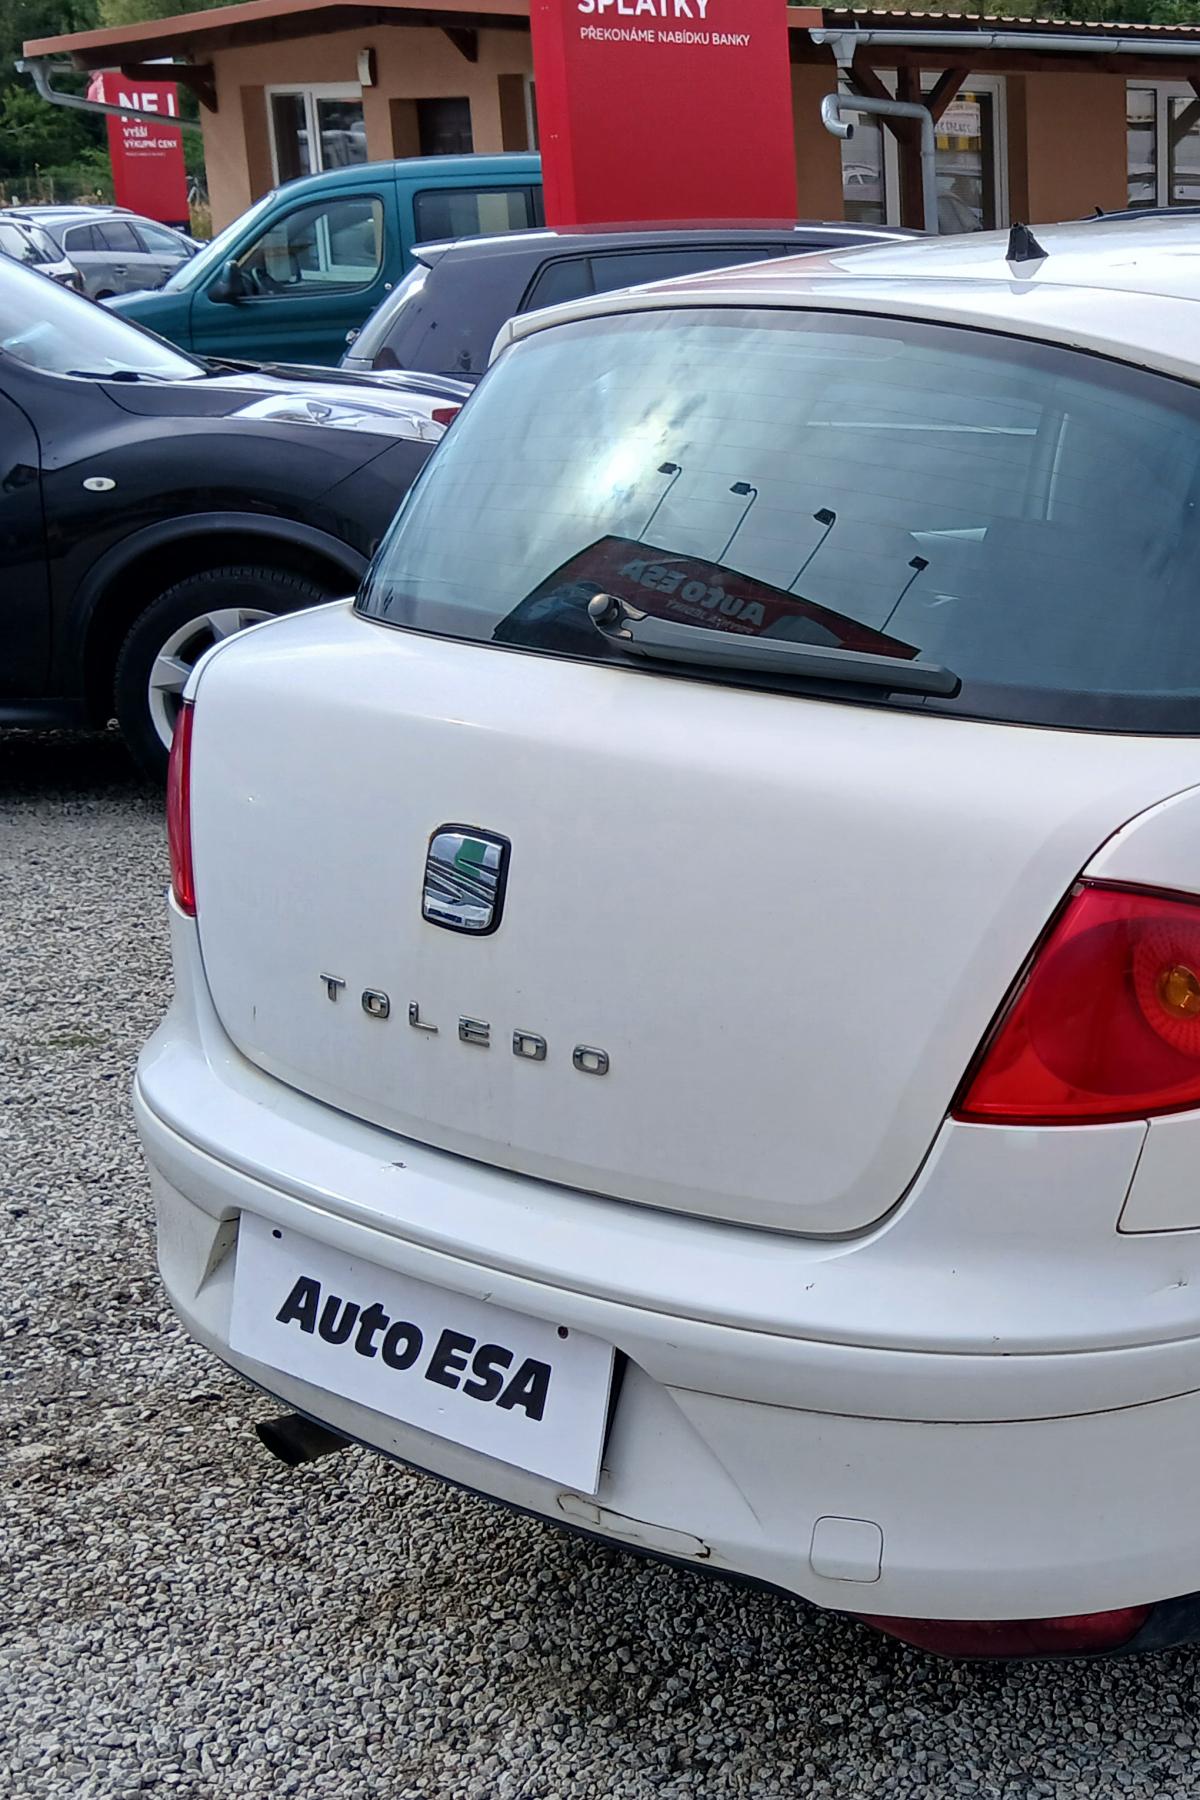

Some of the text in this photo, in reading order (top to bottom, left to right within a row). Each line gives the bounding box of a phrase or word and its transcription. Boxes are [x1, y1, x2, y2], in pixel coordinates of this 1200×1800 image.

[580, 25, 751, 47] PŘEKONÁME NABÍDKU BANKY
[319, 970, 610, 1077] TOLEDO
[424, 1327, 552, 1422] ESA
